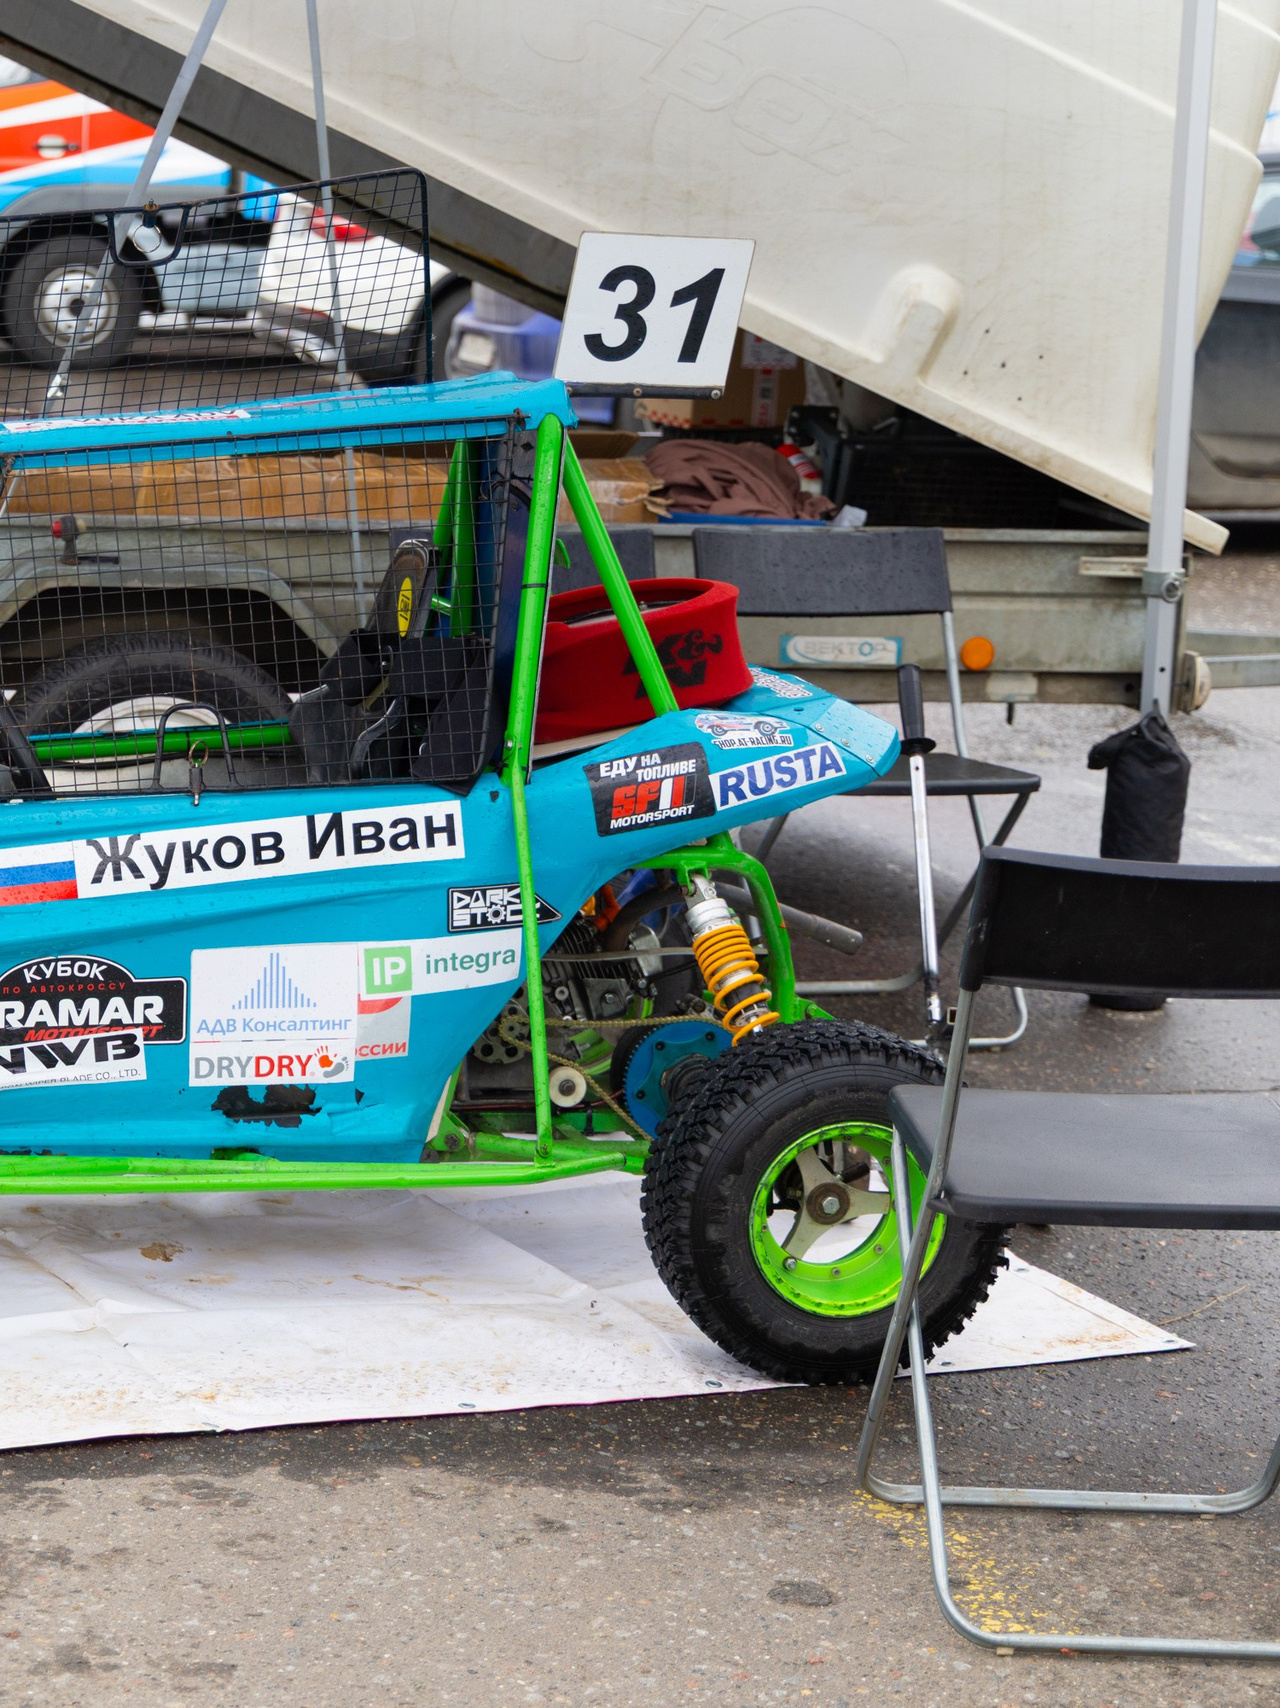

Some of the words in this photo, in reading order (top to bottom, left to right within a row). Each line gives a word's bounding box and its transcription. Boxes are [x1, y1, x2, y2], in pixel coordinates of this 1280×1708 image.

[584, 264, 726, 363] 31
[600, 756, 637, 778] ЕДУ
[641, 753, 660, 767] НА
[636, 759, 696, 782] ТОПЛИВЕ
[720, 745, 843, 807] RUSTA
[610, 805, 695, 829] MOTORSPORT
[86, 830, 285, 890] Жуков
[306, 812, 457, 860] Иван
[23, 960, 108, 984] КУБОК
[372, 956, 407, 986] IP
[426, 948, 516, 974] integra
[3, 986, 21, 994] ПО
[30, 982, 126, 994] АВТОКРОССУ
[24, 1025, 164, 1042] MOTORST
[197, 1018, 237, 1036] АДВ
[242, 1017, 352, 1033] Консалтинг
[355, 1041, 407, 1058] ССИИ
[95, 1071, 116, 1081] CO.,
[119, 1068, 141, 1078] LTD.
